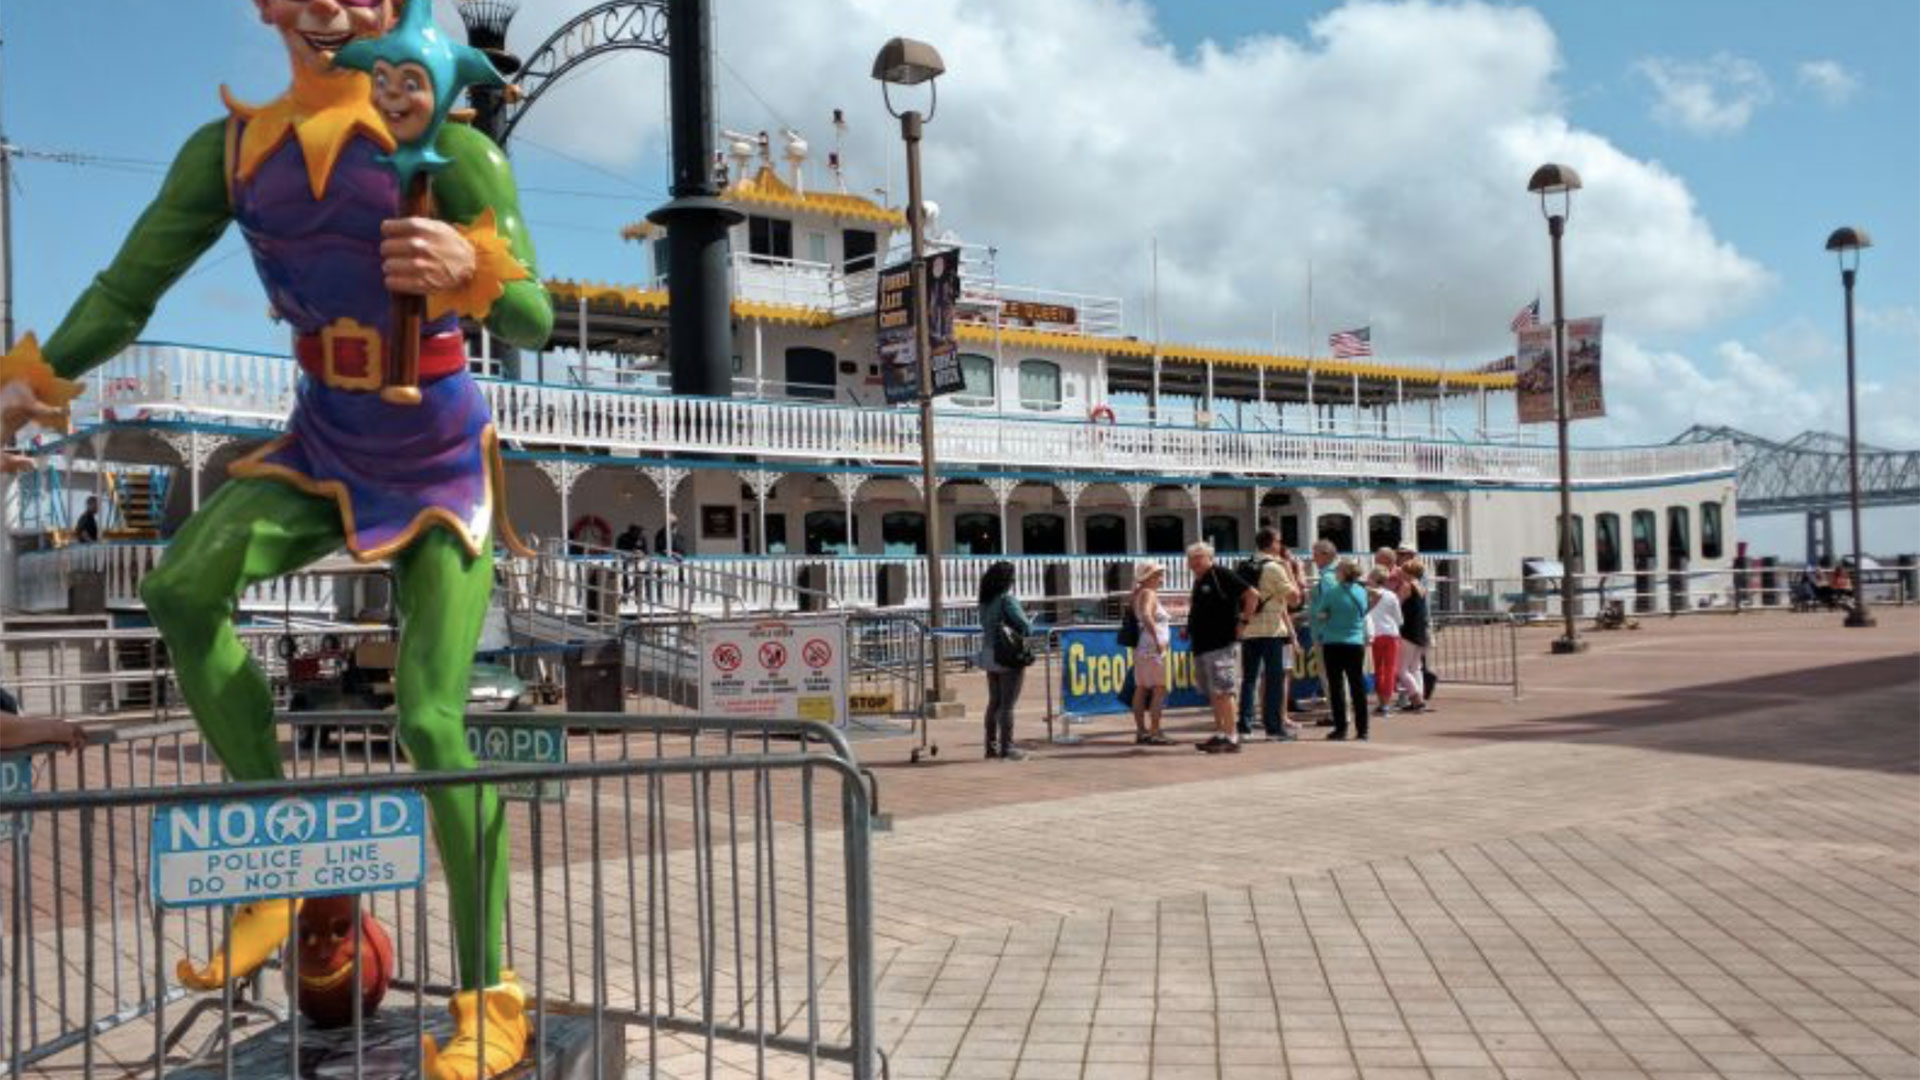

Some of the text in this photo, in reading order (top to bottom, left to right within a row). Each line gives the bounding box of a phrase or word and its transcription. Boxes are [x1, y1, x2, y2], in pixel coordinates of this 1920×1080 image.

[850, 696, 888, 708] STOP
[207, 844, 379, 873] POLICE LINE
[188, 862, 395, 896] DO NOT CROSS
